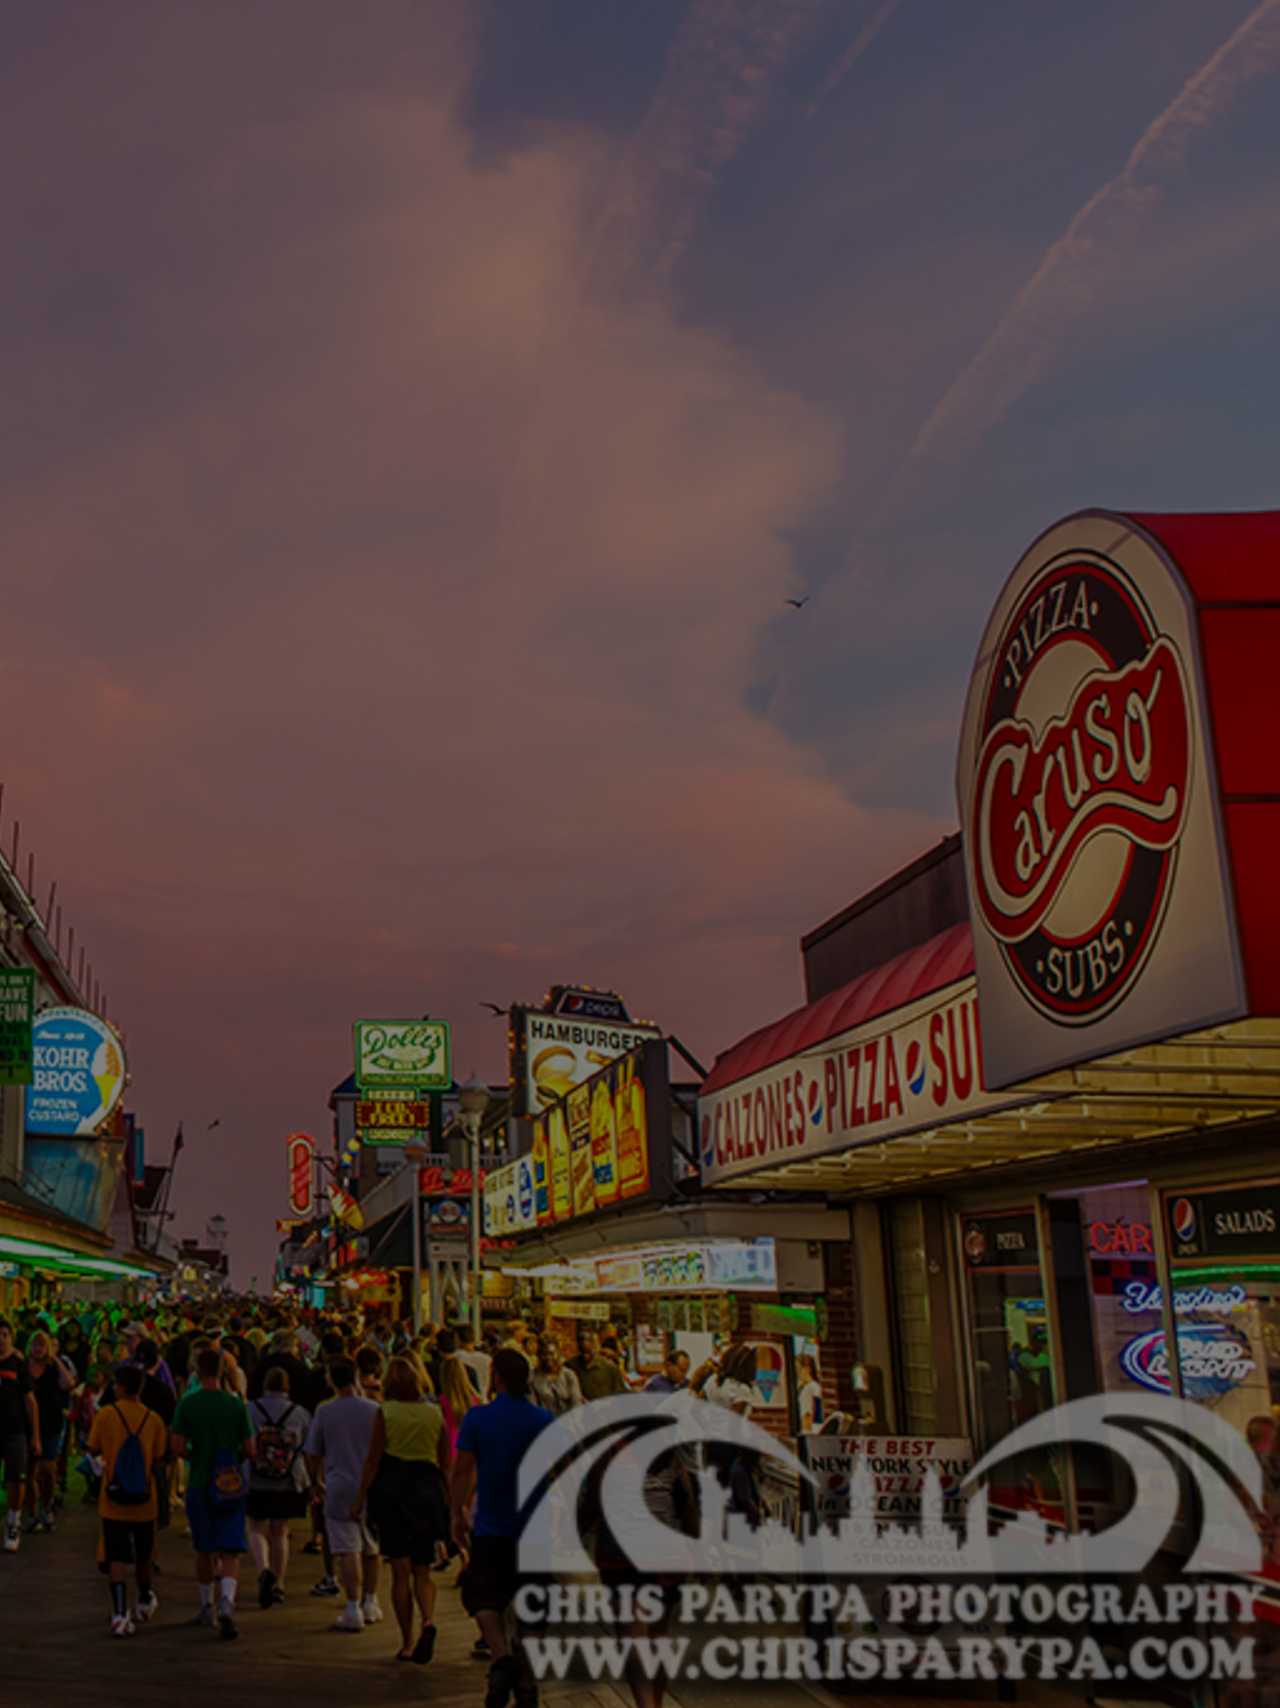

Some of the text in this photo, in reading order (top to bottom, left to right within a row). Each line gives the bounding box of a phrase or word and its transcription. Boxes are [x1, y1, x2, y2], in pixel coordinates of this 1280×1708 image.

[1007, 579, 1091, 688] PIZZA
[981, 667, 1178, 918] Caruso
[1045, 923, 1124, 1001] SUBS
[33, 1046, 91, 1069] KOHR
[714, 998, 987, 1167] CALZONES PIZZA SU
[1214, 1208, 1277, 1236] SALADS
[812, 1457, 851, 1472] NEW
[866, 1458, 913, 1474] ORK
[886, 1438, 936, 1456] BEST
